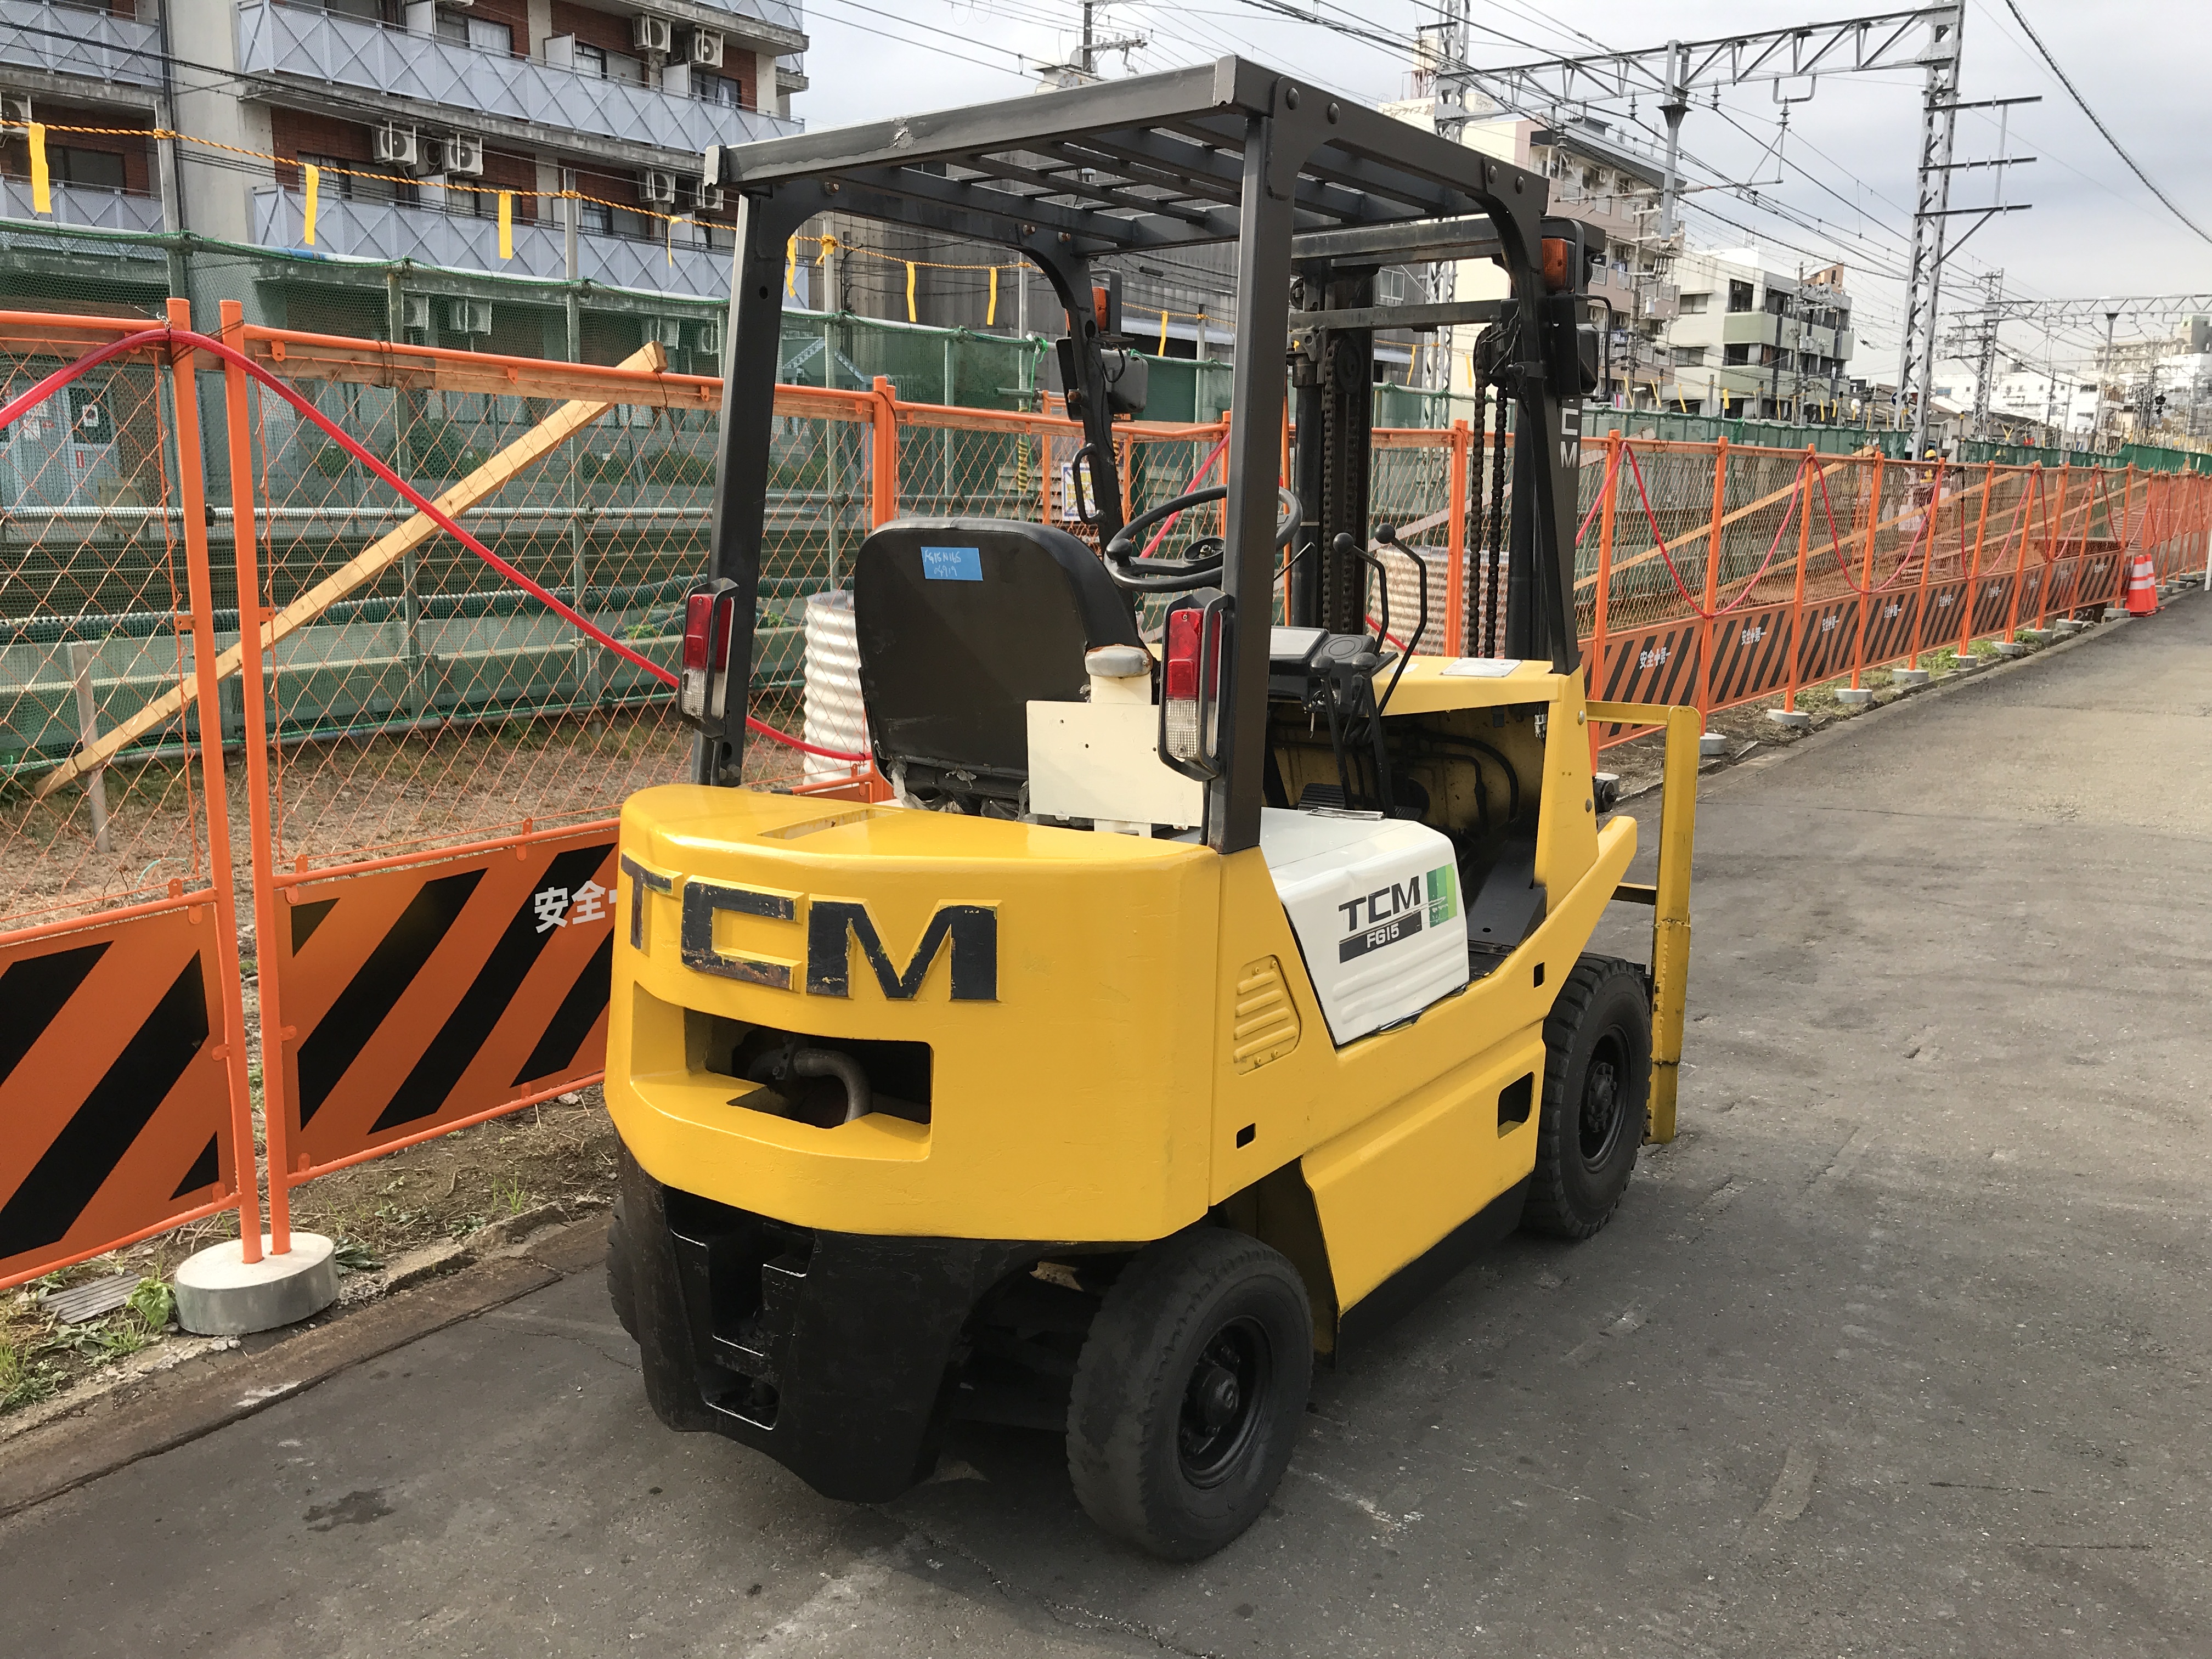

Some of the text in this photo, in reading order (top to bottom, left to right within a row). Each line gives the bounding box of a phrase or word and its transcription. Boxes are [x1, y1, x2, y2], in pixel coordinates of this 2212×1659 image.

[1560, 399, 1579, 468] CM
[620, 849, 1001, 1001] TCM
[1339, 876, 1421, 932] TCM
[1367, 923, 1400, 949] FG15
